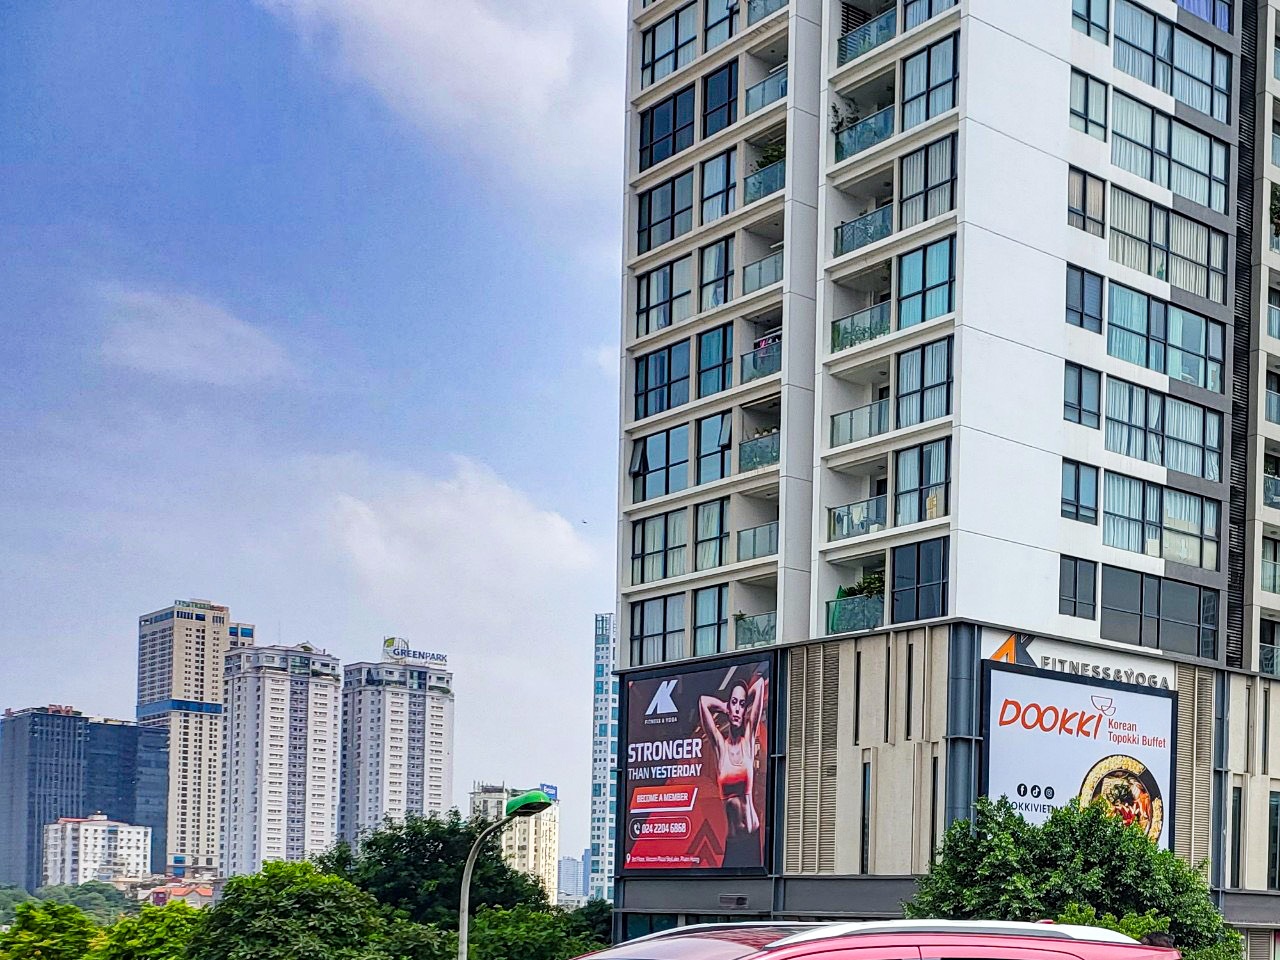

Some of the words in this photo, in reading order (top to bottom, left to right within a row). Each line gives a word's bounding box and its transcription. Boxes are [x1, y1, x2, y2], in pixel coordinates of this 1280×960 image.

[393, 648, 448, 662] GREENPARK
[998, 698, 1104, 740] DOOKKI
[1108, 718, 1137, 732] Korean
[1107, 731, 1140, 746] Topokki
[1141, 735, 1167, 748] Buffet
[627, 738, 703, 763] STRONGER
[627, 767, 651, 780] THAN
[651, 763, 703, 779] YESTERDAY
[636, 793, 659, 803] BECOME
[658, 793, 664, 802] A
[663, 792, 689, 802] MEMBER
[641, 823, 653, 834] 024
[653, 823, 669, 834] 2204
